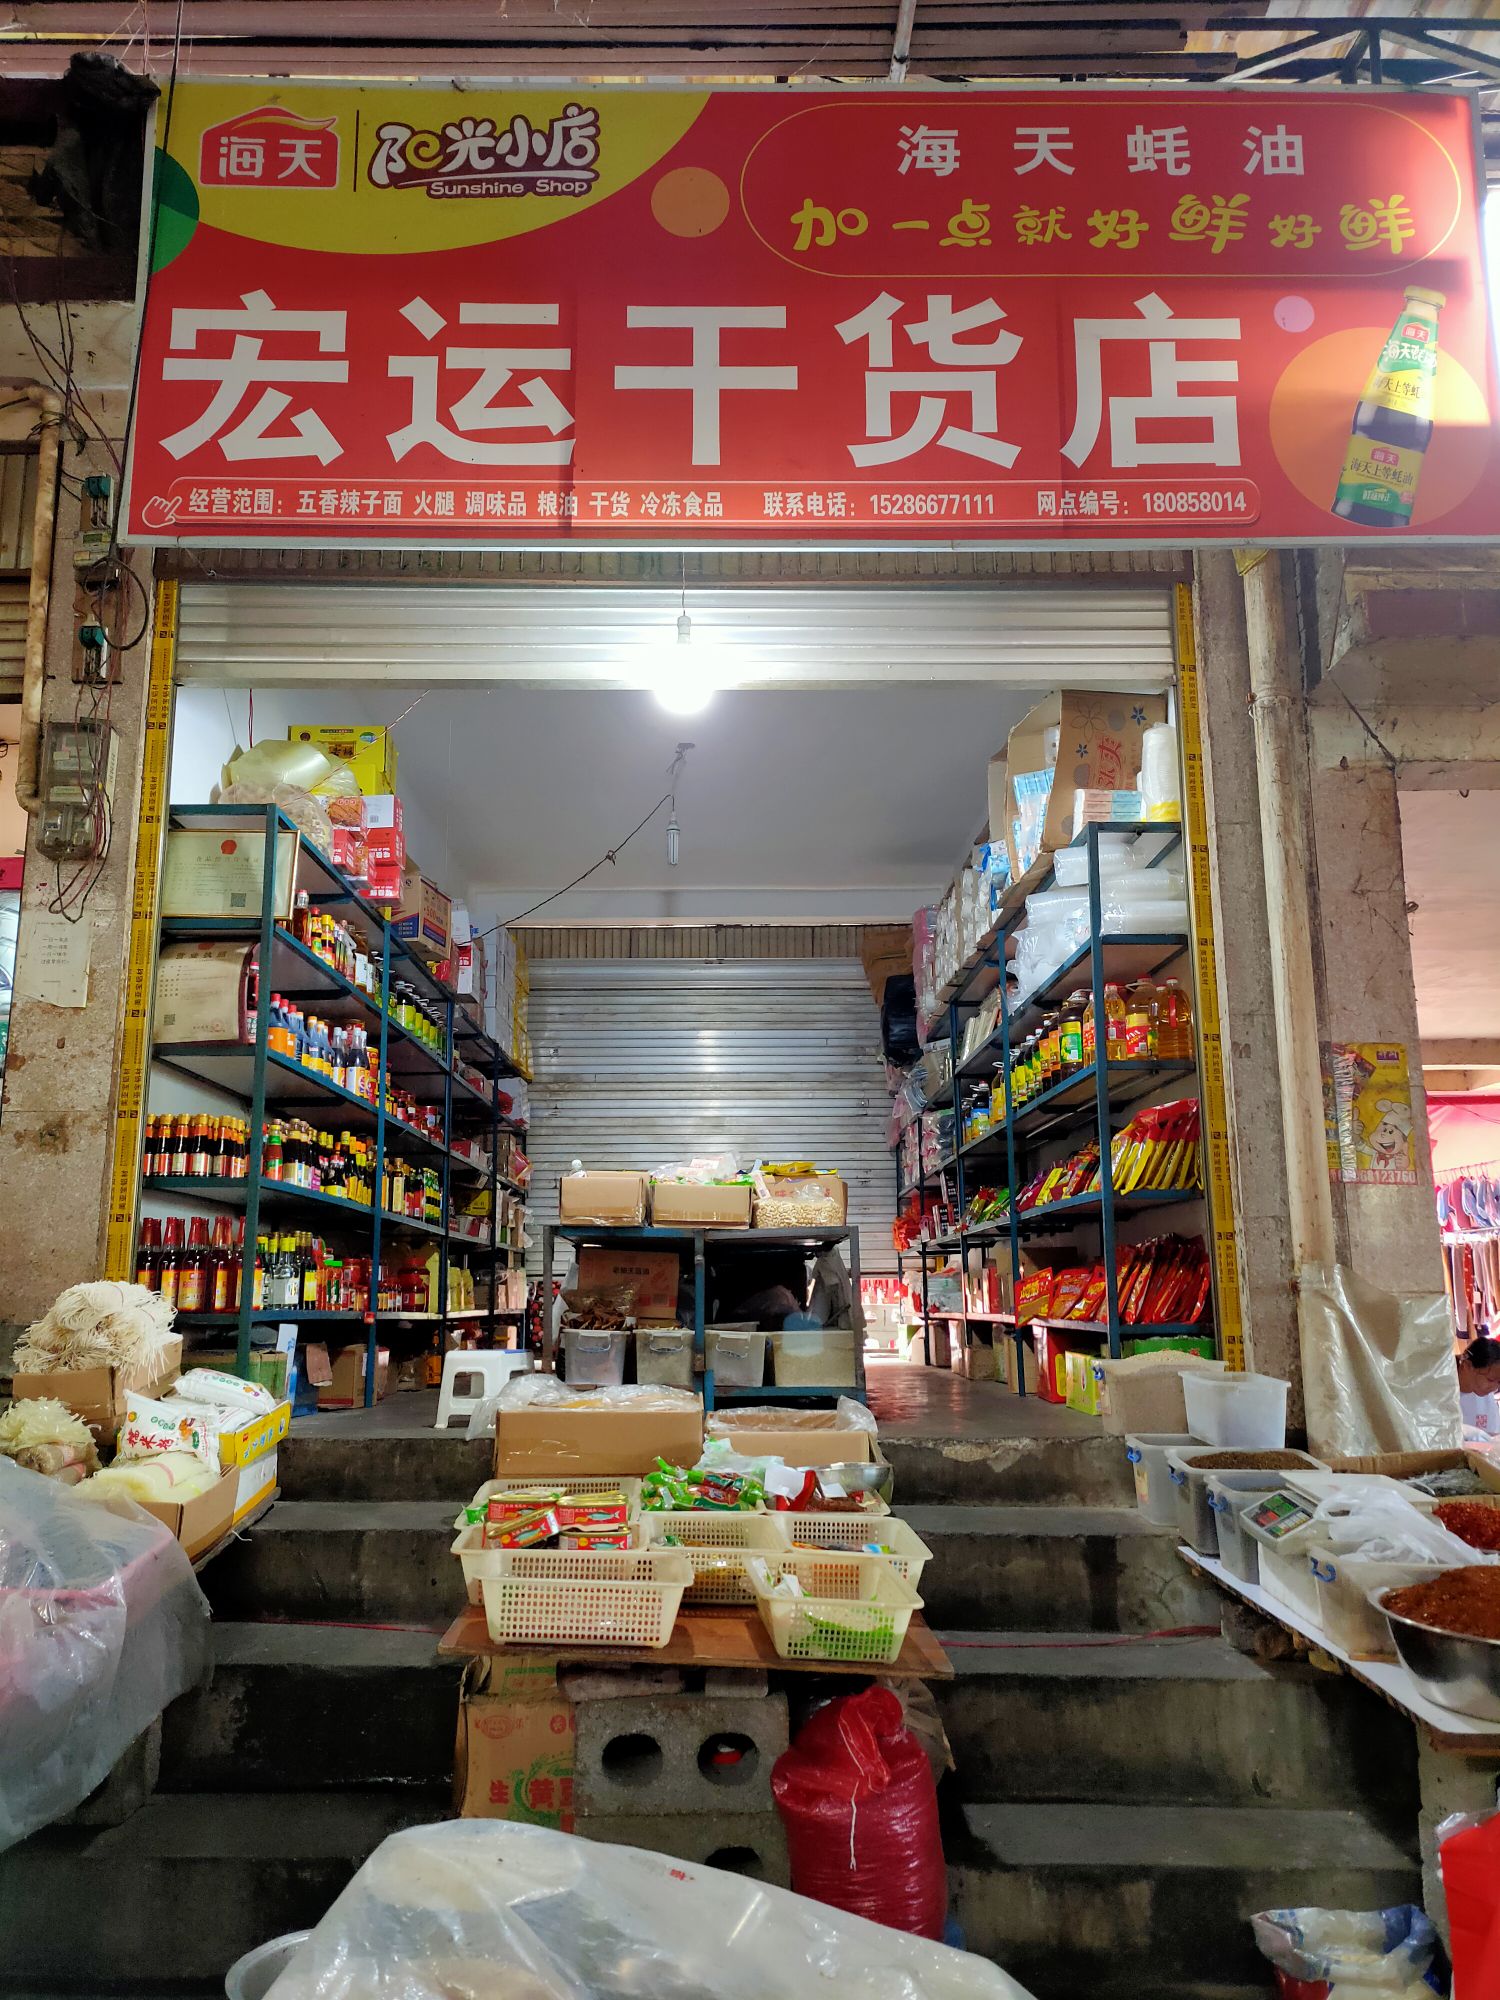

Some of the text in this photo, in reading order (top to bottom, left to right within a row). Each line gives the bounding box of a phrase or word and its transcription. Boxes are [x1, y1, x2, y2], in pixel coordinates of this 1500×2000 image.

[219, 135, 322, 180] 海天
[370, 104, 598, 185] 阳光小店
[896, 123, 1306, 177] 海天蚝油
[430, 177, 589, 196] Sunshine Shop
[158, 288, 1243, 470] 宏运干货店
[296, 489, 404, 515] 五香辣子面
[412, 490, 455, 516] 火腿
[465, 491, 527, 517] 调味品
[537, 491, 578, 517] 粮油
[589, 491, 631, 517] 干货
[640, 491, 723, 517] 冷冻食品
[869, 493, 995, 515] 15286677111
[1142, 491, 1247, 513] 180858014
